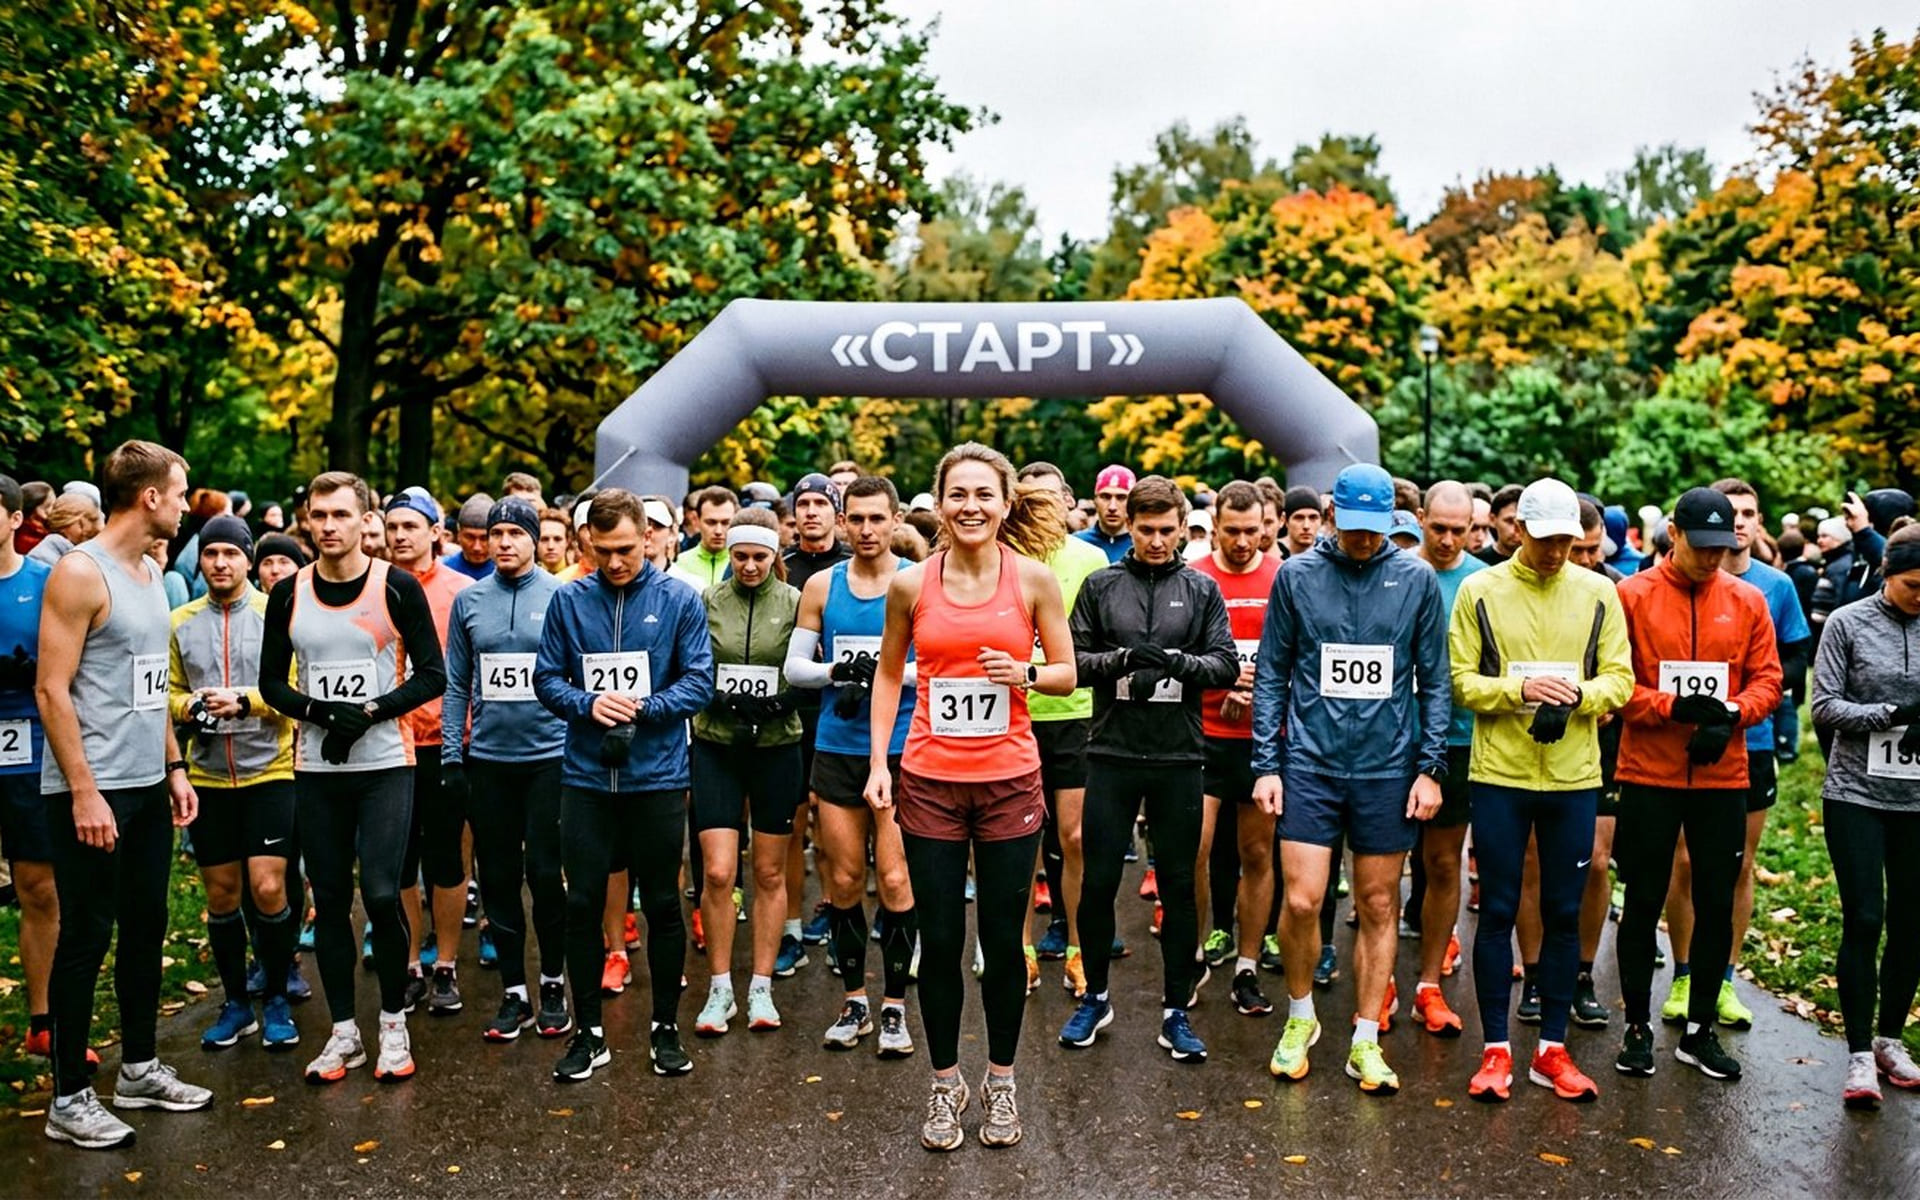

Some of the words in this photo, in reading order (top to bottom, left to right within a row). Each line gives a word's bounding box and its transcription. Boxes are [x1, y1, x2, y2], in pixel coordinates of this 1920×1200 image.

[831, 320, 1145, 373] «СТАРТ»
[144, 668, 169, 695] 14
[489, 667, 529, 688] 451
[591, 666, 639, 691] 219
[1331, 659, 1383, 685] 508
[317, 674, 367, 699] 142
[1672, 675, 1718, 697] 199
[941, 694, 997, 721] 317
